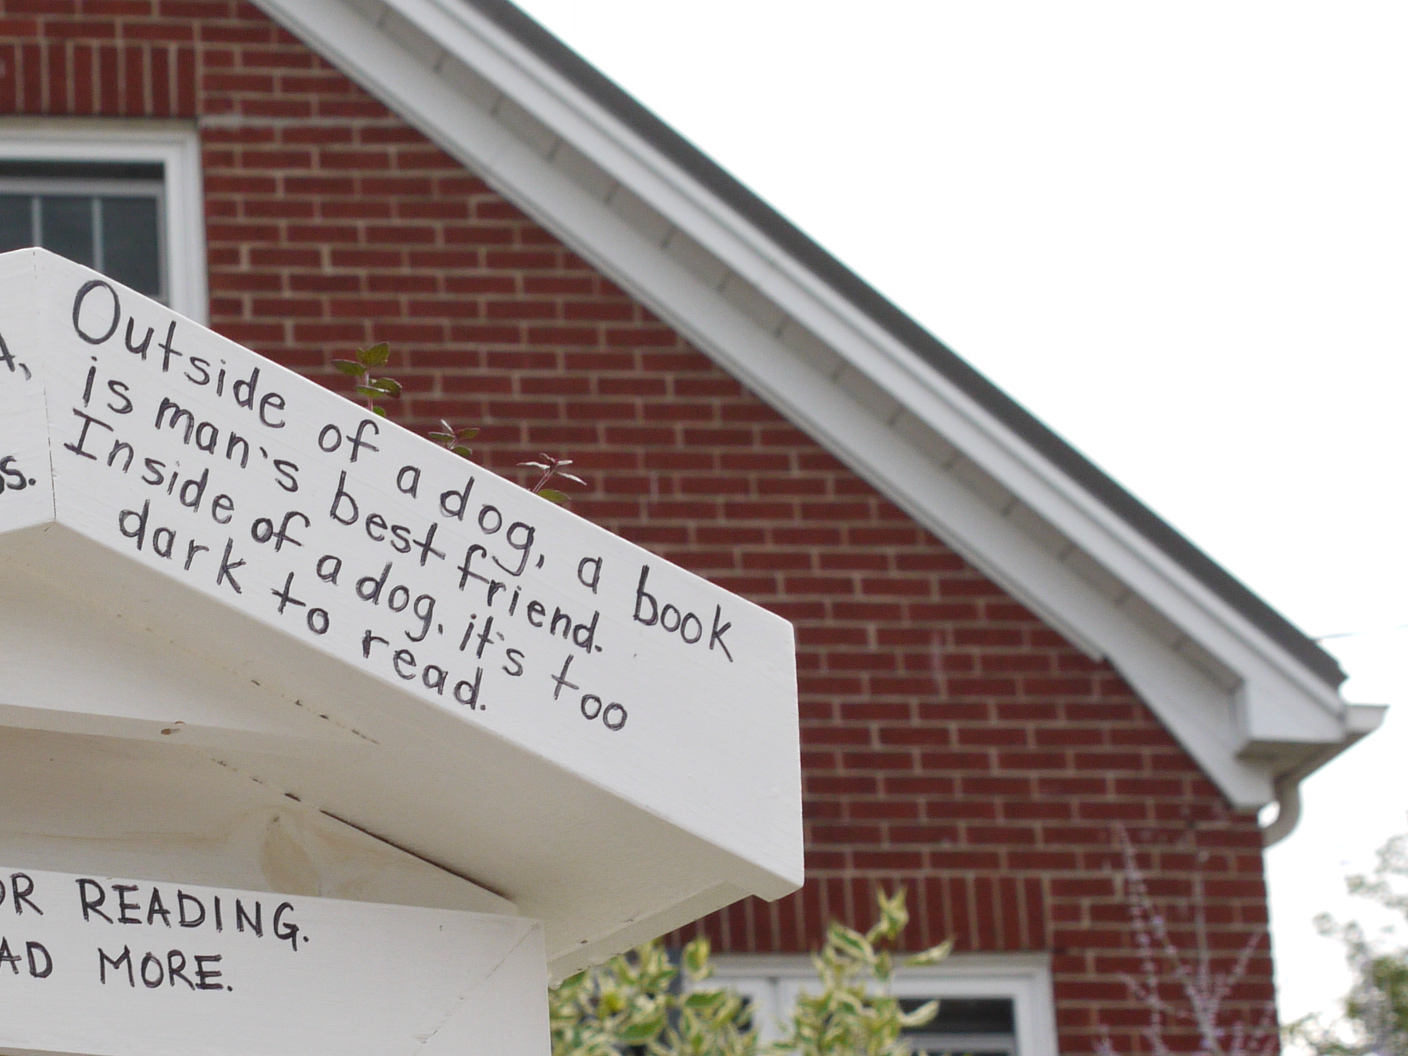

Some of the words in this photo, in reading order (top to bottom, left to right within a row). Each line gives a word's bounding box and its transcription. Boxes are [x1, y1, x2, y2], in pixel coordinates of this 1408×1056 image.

[64, 407, 235, 524] Inside
[251, 511, 310, 553] of
[316, 555, 343, 586] a
[460, 613, 524, 676] it's
[552, 654, 628, 731] too
[72, 279, 285, 428] Outside
[318, 419, 380, 463] of
[396, 465, 421, 498] a
[440, 476, 545, 576] dog,
[577, 556, 603, 594] a
[633, 565, 733, 662] book
[82, 356, 134, 414] is
[154, 397, 299, 492] man's
[330, 470, 445, 566] best
[457, 544, 603, 653] friend.
[119, 499, 246, 594] dark
[272, 572, 330, 634] to
[362, 629, 486, 711] read.
[78, 878, 310, 952] READING.
[99, 947, 235, 993] MORE.
